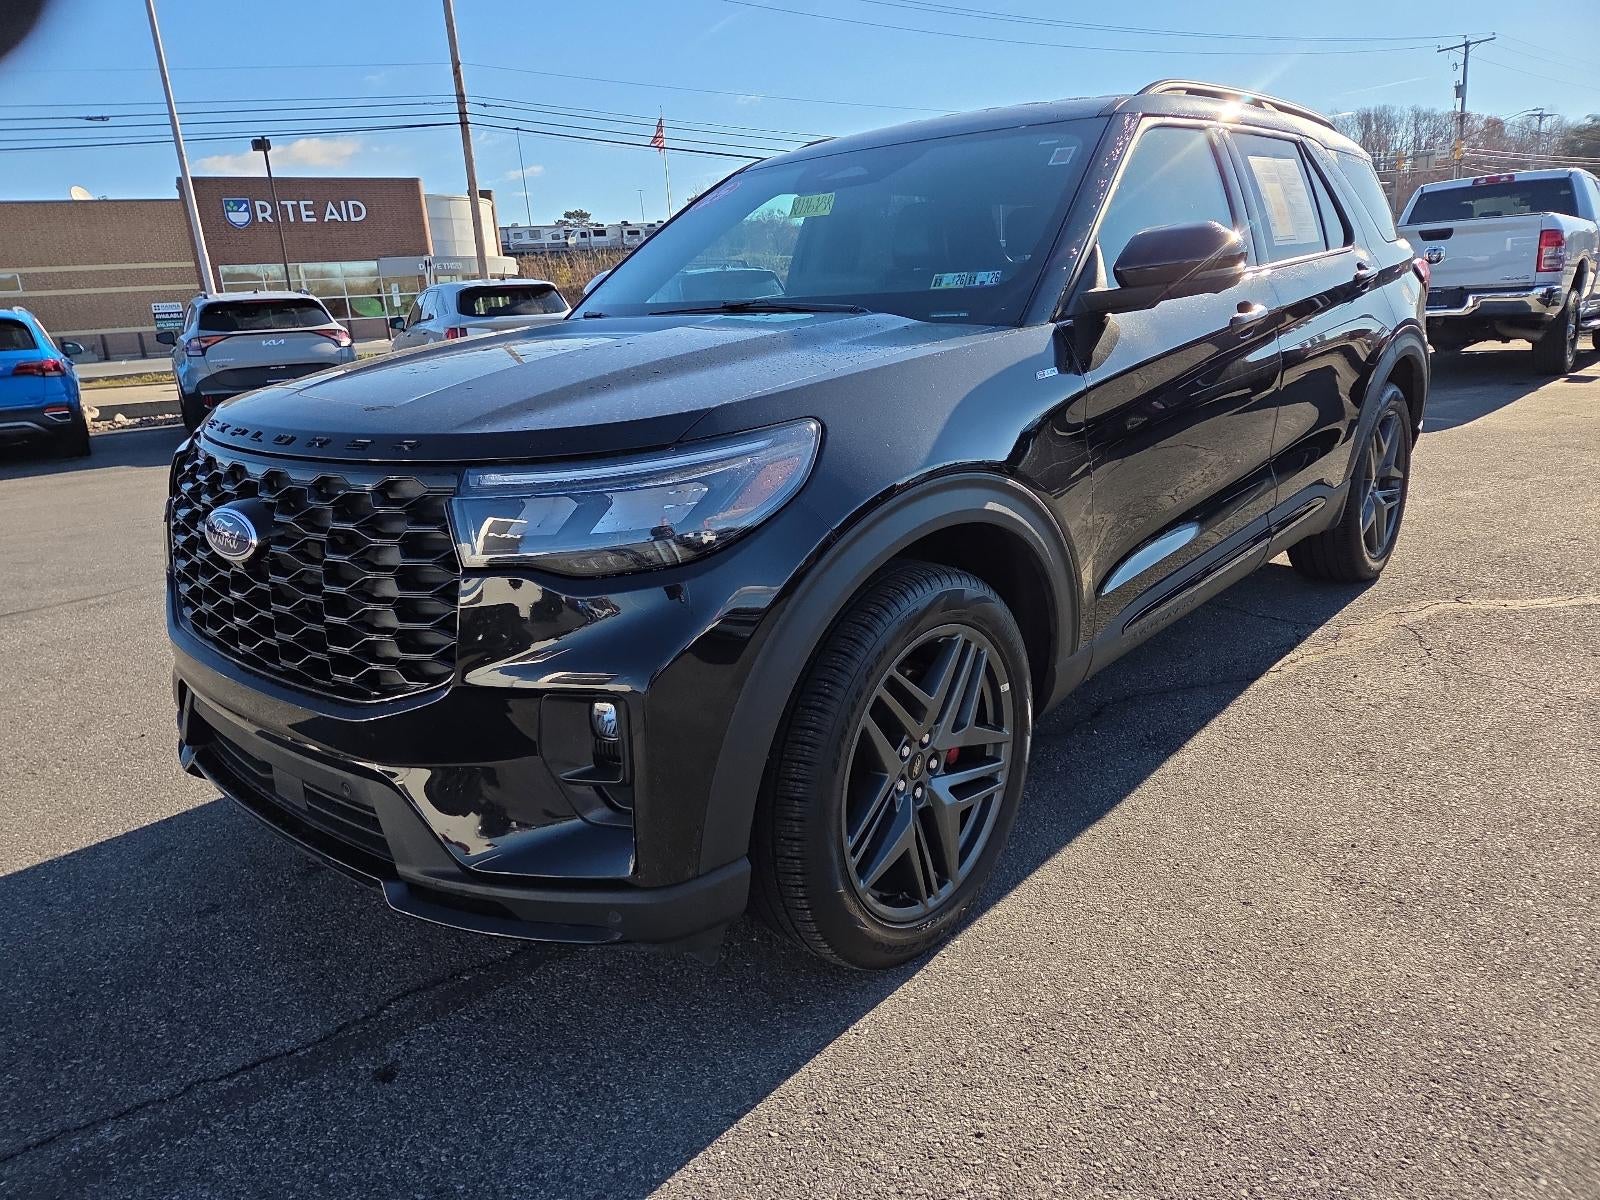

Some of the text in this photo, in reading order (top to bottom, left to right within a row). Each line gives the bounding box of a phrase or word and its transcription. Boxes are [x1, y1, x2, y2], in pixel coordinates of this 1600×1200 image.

[323, 200, 367, 222] AID
[990, 272, 999, 283] 26
[206, 419, 422, 451] EXPLORER
